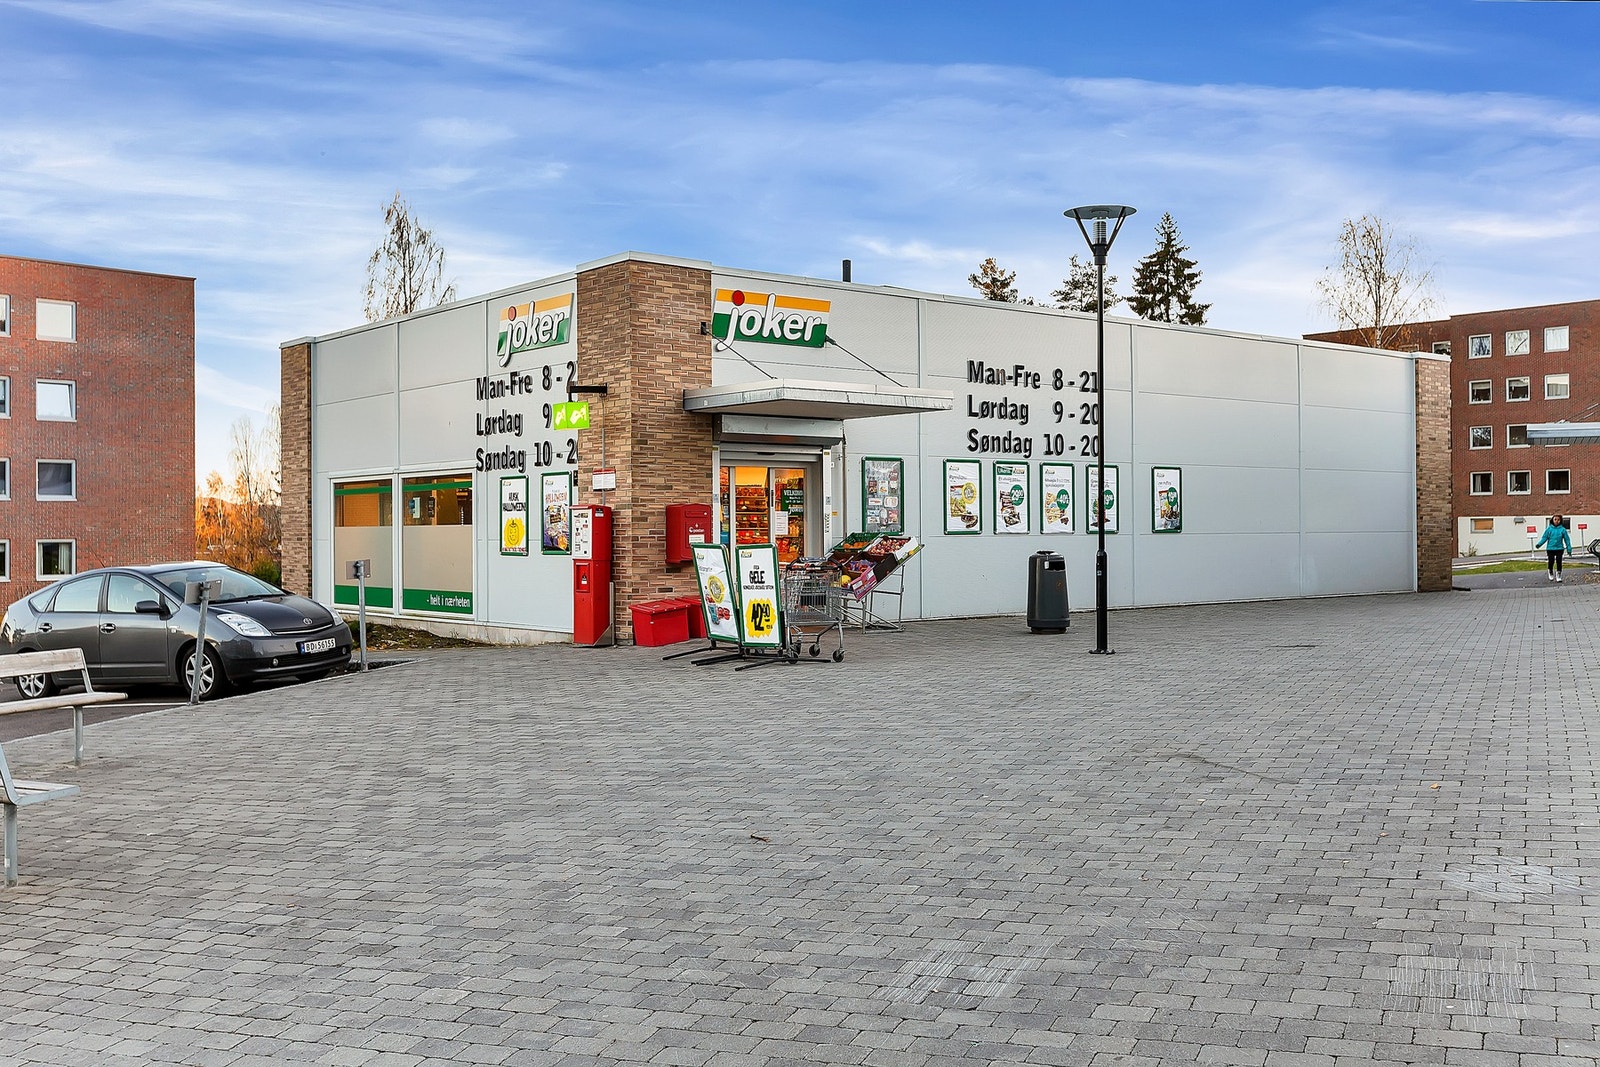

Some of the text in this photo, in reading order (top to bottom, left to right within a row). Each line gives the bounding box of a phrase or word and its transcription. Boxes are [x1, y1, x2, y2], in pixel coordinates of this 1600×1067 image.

[499, 301, 564, 367] joker
[716, 290, 822, 352] joker
[476, 371, 533, 400] Man-Fre
[542, 365, 552, 391] 8
[567, 361, 577, 389] 2
[967, 360, 1040, 389] Man-Fre
[1052, 368, 1063, 391] 8
[1079, 371, 1098, 393] 21
[476, 403, 552, 437] Lørdag 9
[967, 395, 1028, 425] Lørdag
[1053, 401, 1063, 423] 9
[1080, 403, 1098, 425] 20
[476, 445, 527, 473] Søndag
[534, 441, 552, 467] 10
[567, 438, 578, 464] 2
[967, 428, 1032, 458] Søndag
[1043, 433, 1064, 456] 10
[1080, 435, 1098, 457] 20
[445, 595, 470, 607] nærheten
